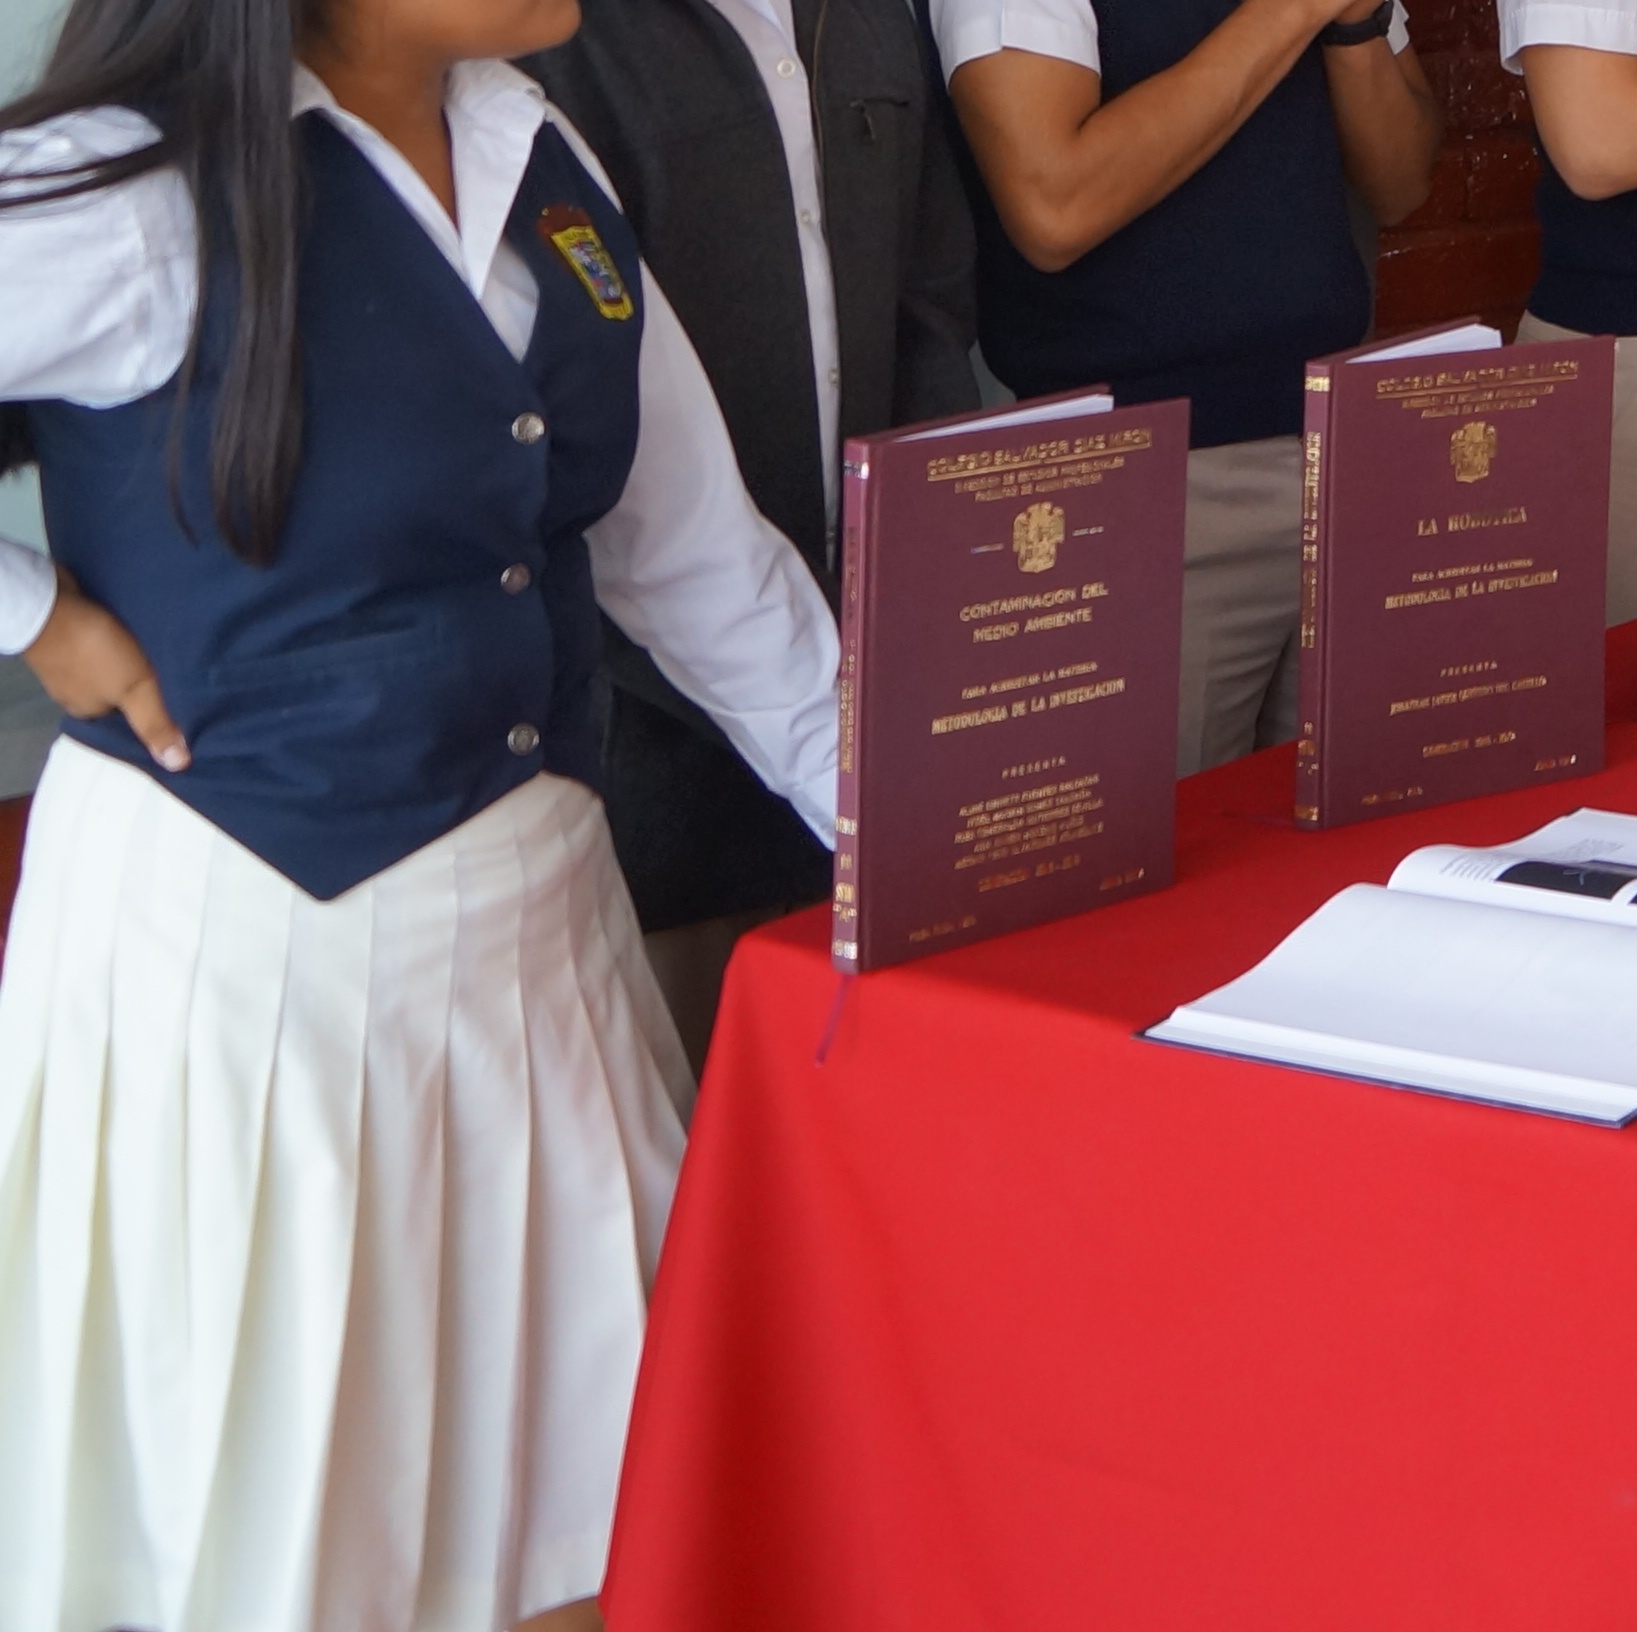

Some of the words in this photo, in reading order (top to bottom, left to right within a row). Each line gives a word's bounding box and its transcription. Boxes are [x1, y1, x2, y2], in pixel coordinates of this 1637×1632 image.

[1417, 518, 1438, 536] LA
[1081, 581, 1109, 599] DEL
[973, 621, 1019, 643] MEDIO
[1024, 607, 1093, 633] AMBIENTE
[1012, 700, 1027, 718] DE
[1030, 696, 1046, 713] LA
